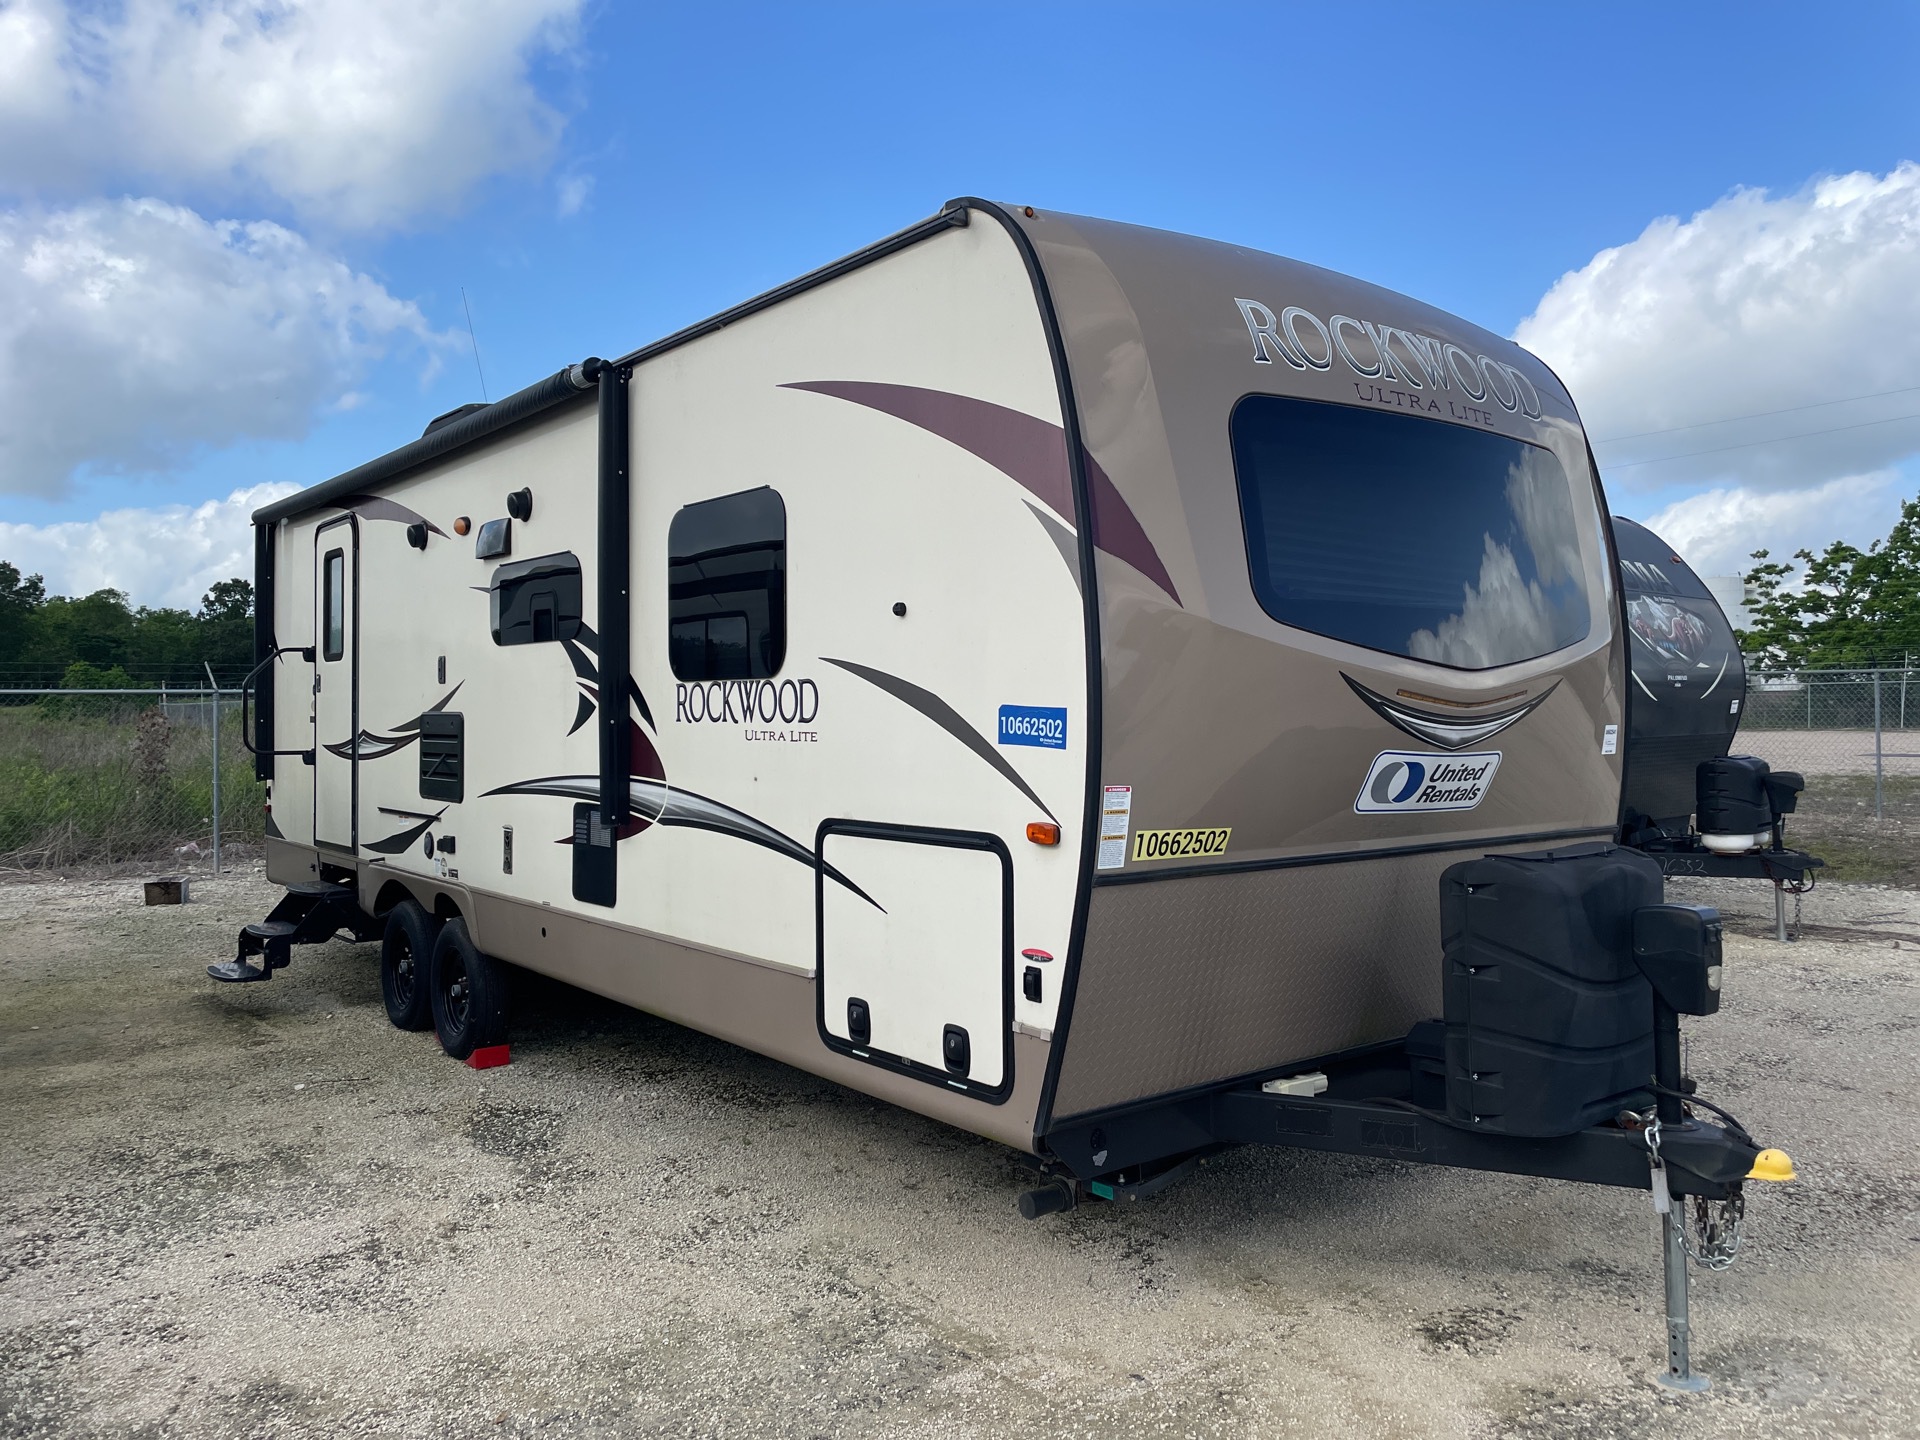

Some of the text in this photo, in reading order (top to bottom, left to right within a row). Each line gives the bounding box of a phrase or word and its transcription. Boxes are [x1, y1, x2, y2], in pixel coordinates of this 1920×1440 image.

[1233, 297, 1543, 422] ROCKWOOD
[1353, 382, 1495, 427] ULTRA LITE
[675, 678, 819, 724] ROCKWOOD
[744, 729, 818, 742] ULTRA LITE
[1000, 716, 1063, 738] 10662502
[1429, 762, 1490, 783] United
[1415, 783, 1481, 803] Rentals
[1136, 829, 1228, 858] 10662502
